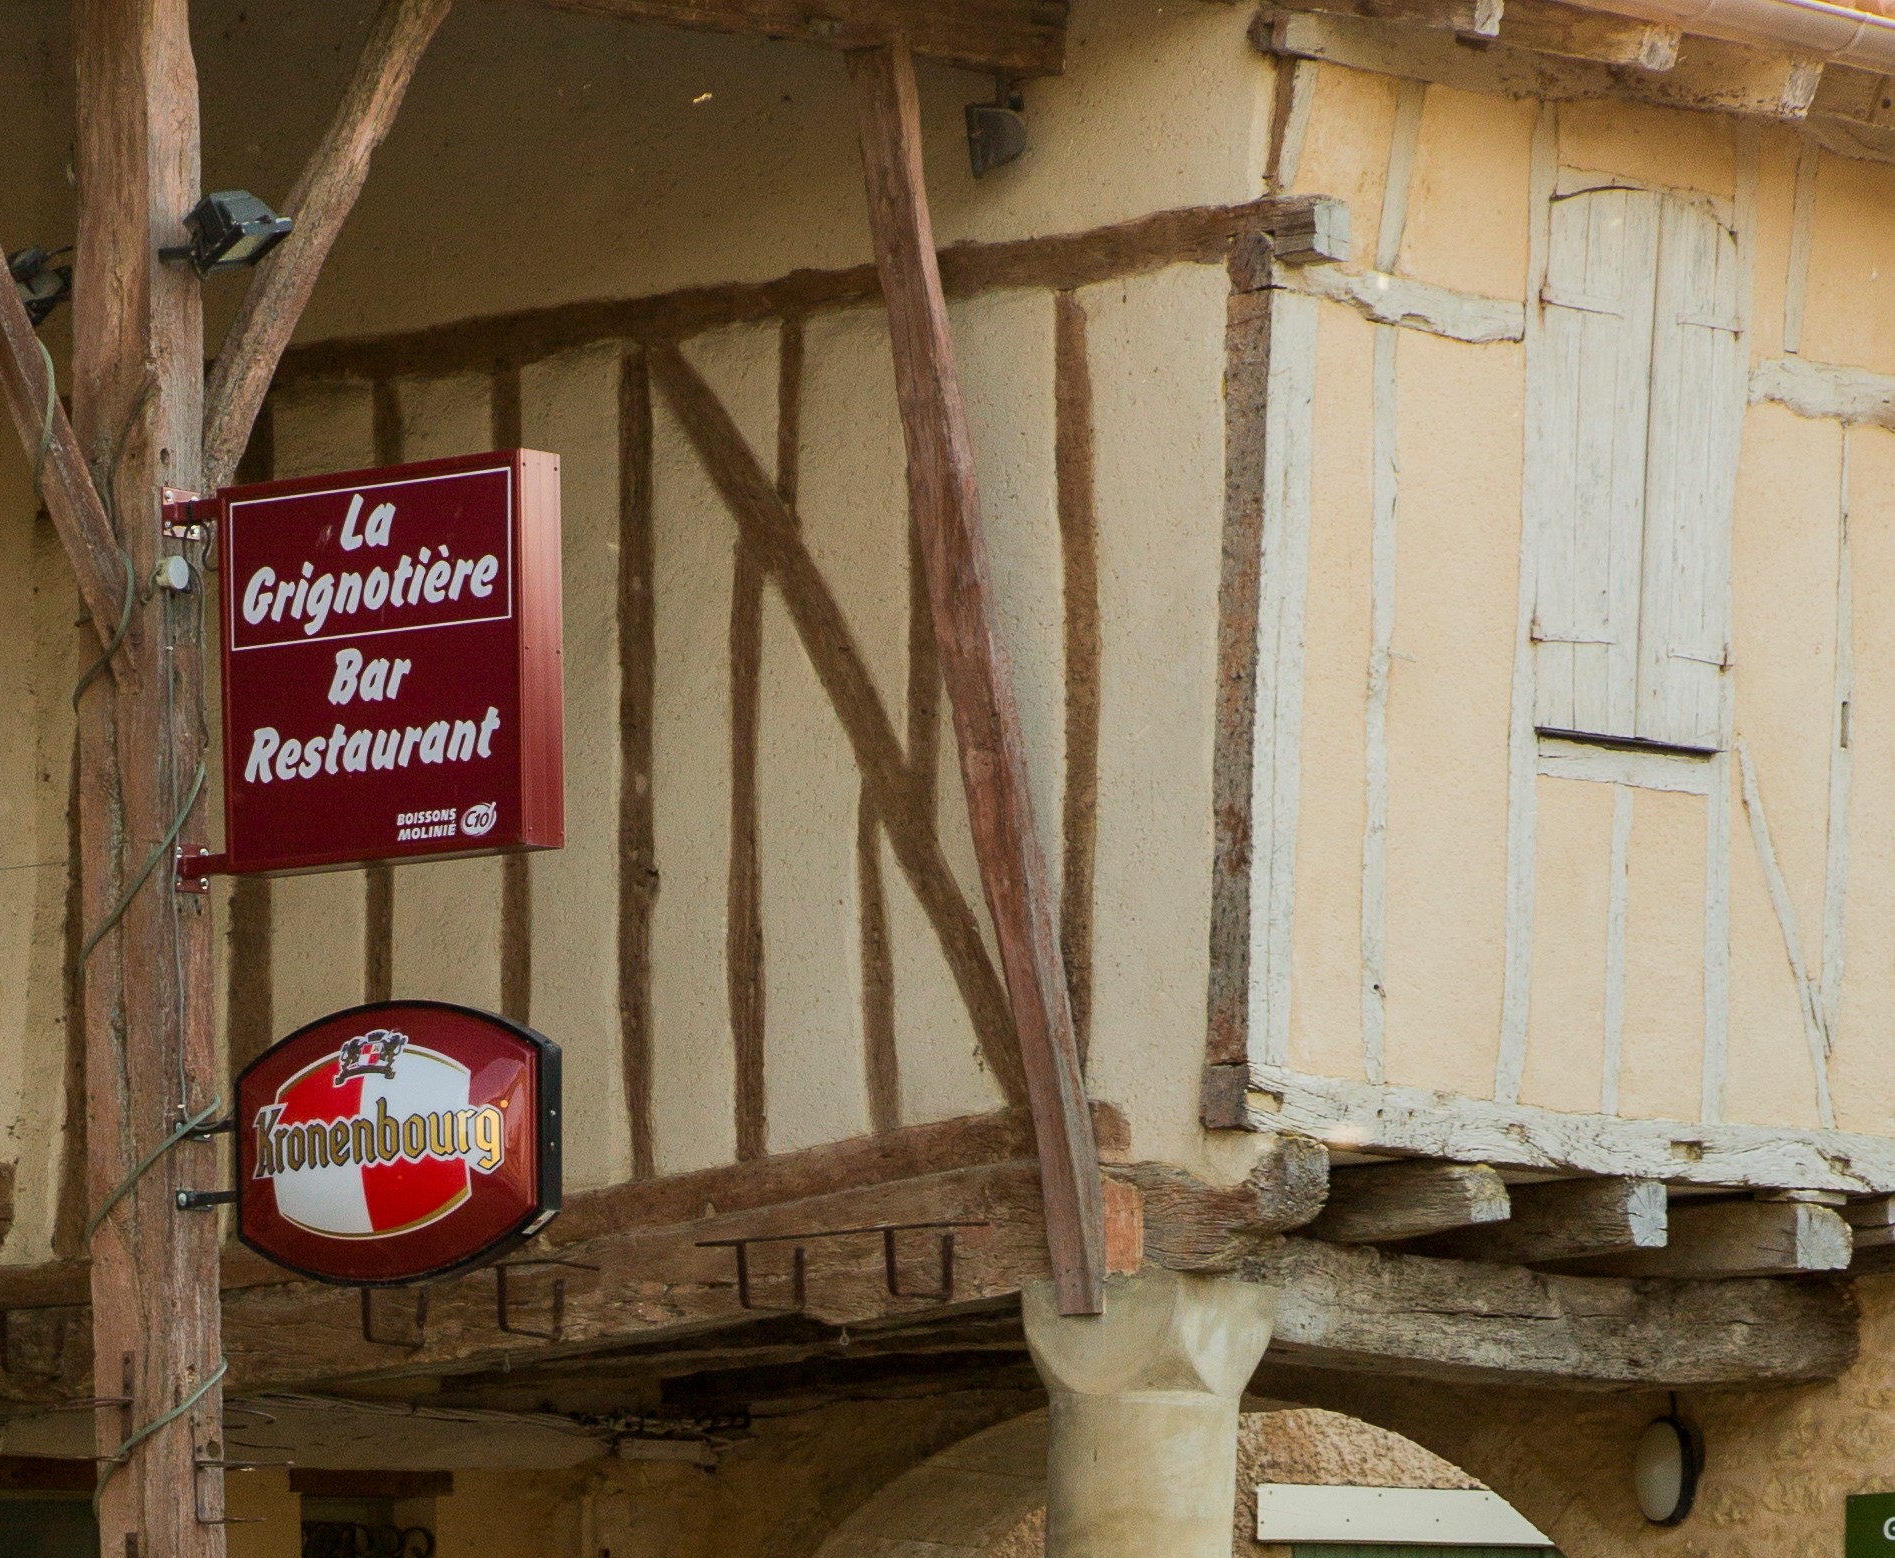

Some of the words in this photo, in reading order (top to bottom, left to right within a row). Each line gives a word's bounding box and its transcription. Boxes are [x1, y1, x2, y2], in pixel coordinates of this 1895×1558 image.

[340, 494, 396, 550] La
[243, 544, 499, 635] Grignotière
[328, 648, 411, 705] Bar
[244, 706, 501, 783] Restaurant
[397, 808, 457, 826] BOISSONS
[397, 821, 456, 841] MOLINIÉ
[465, 811, 490, 828] C10
[254, 1097, 504, 1178] Kronenbourg
